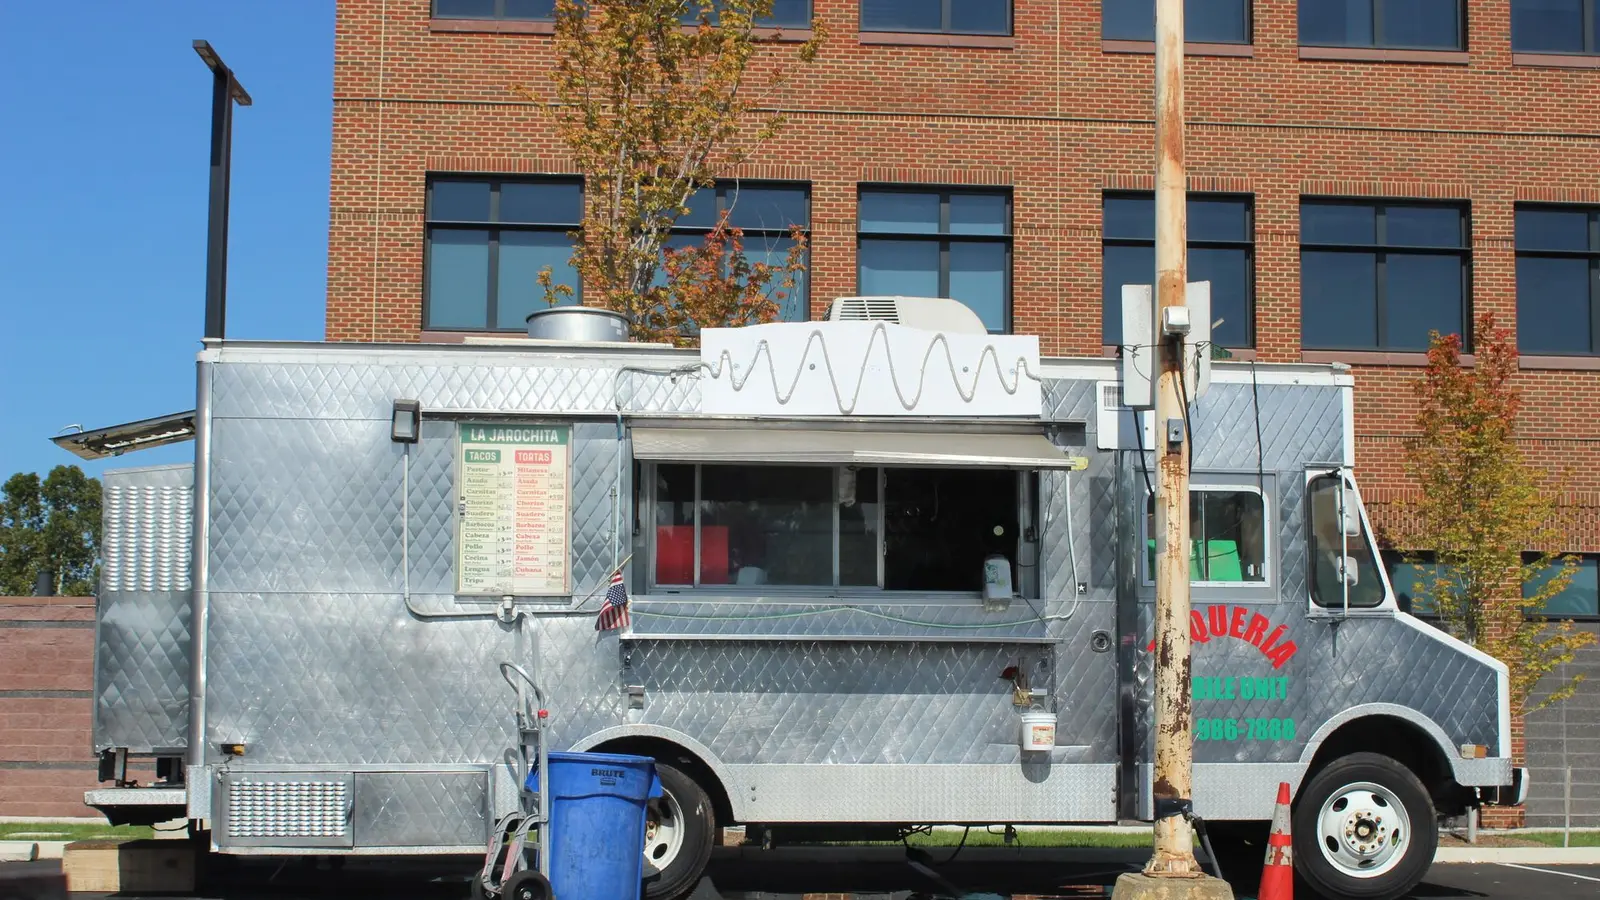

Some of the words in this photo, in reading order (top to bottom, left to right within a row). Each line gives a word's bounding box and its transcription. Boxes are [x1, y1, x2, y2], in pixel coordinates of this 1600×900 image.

[471, 428, 486, 441] LA
[489, 428, 559, 442] JAROCHITA
[469, 451, 497, 461] TACOS
[518, 452, 550, 461] TORTAS
[1146, 604, 1298, 670] QUERÍA
[1191, 676, 1236, 700] BILE
[1240, 676, 1289, 700] UNIT
[1191, 717, 1296, 741] -986-7888
[592, 769, 624, 778] BRUTE
